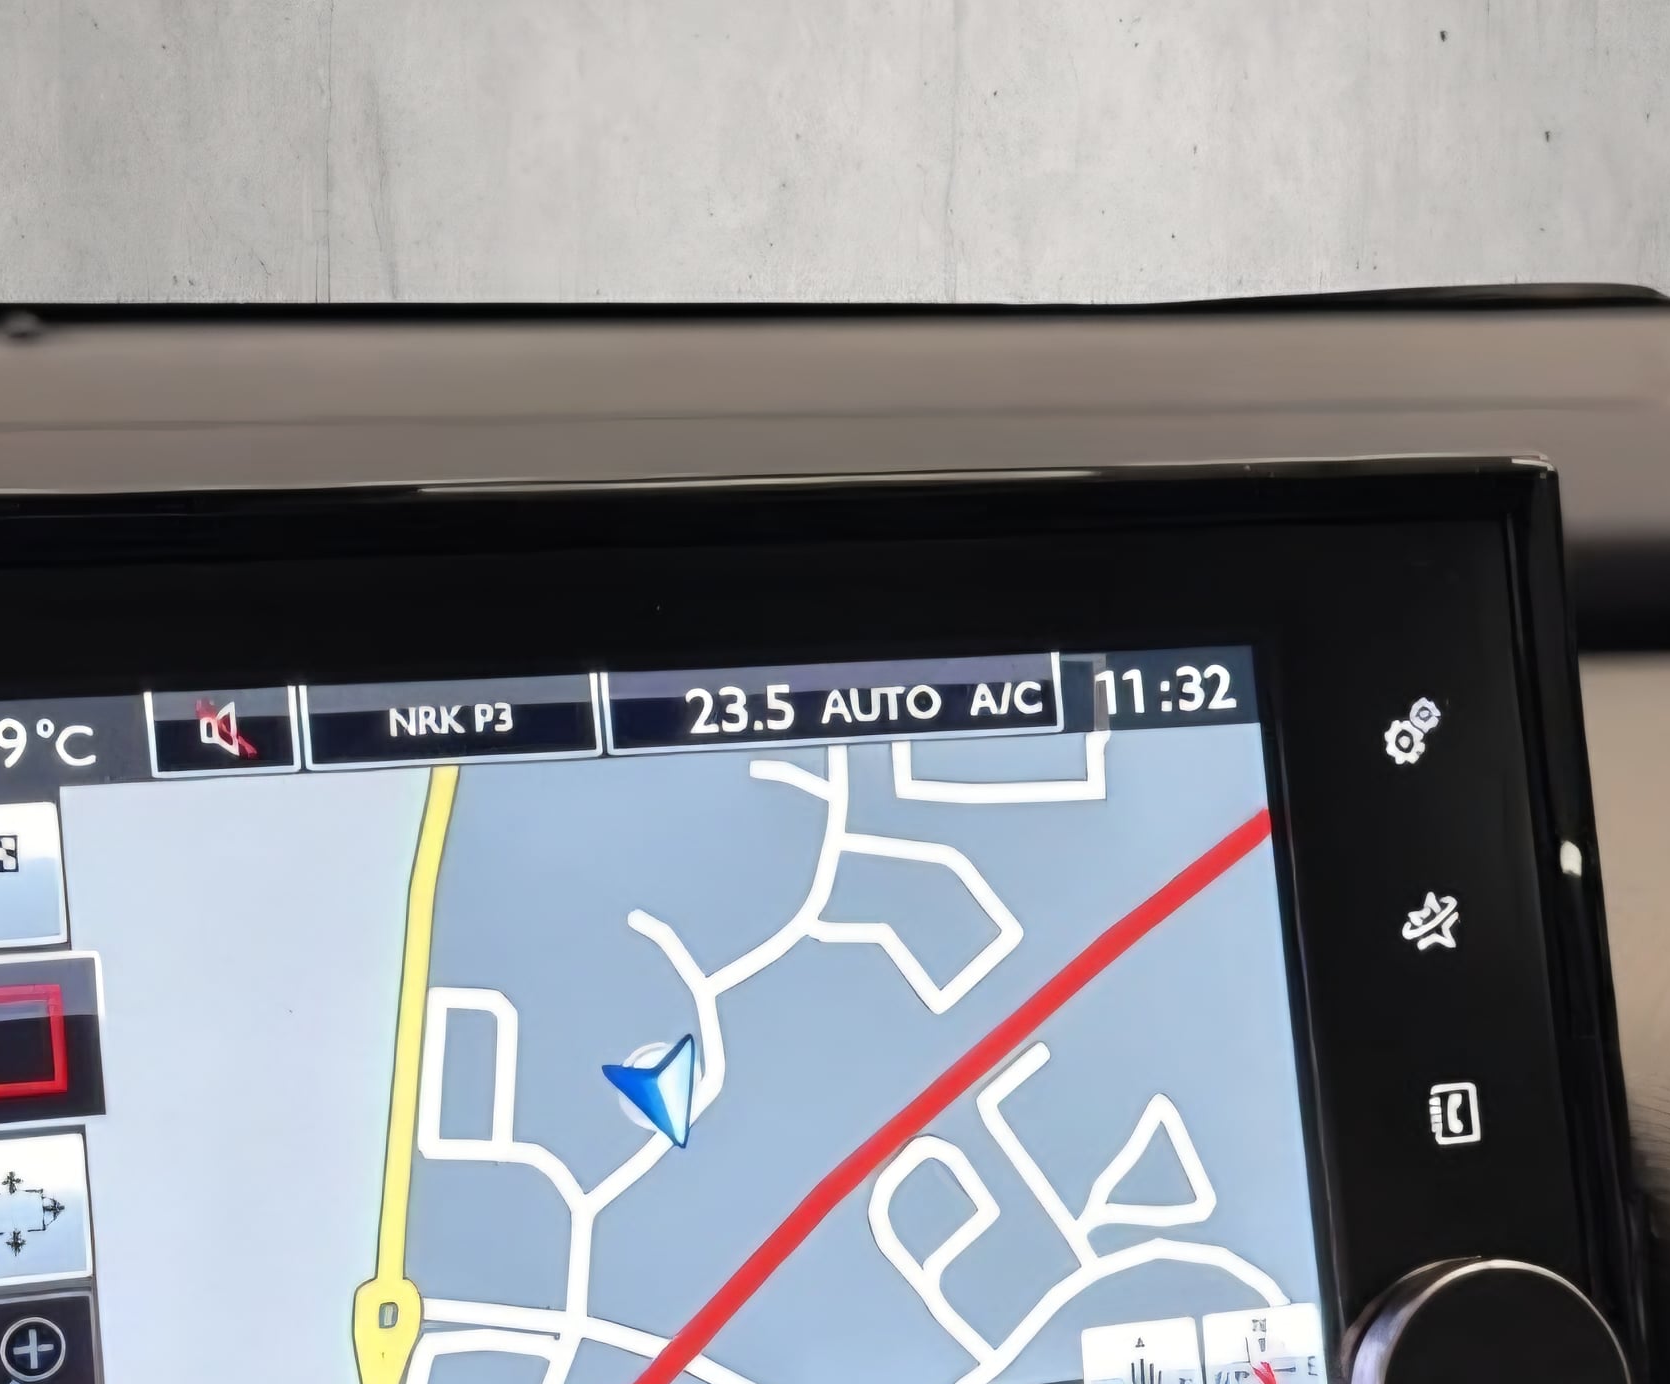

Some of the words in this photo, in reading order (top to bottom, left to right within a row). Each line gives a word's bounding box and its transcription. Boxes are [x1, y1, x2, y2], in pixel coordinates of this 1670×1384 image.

[685, 683, 795, 735] 23.5
[820, 684, 943, 724] AUTO
[969, 679, 1045, 717] A/C
[1094, 663, 1237, 716] 11:32
[388, 706, 462, 738] NRK
[474, 702, 514, 733] P3
